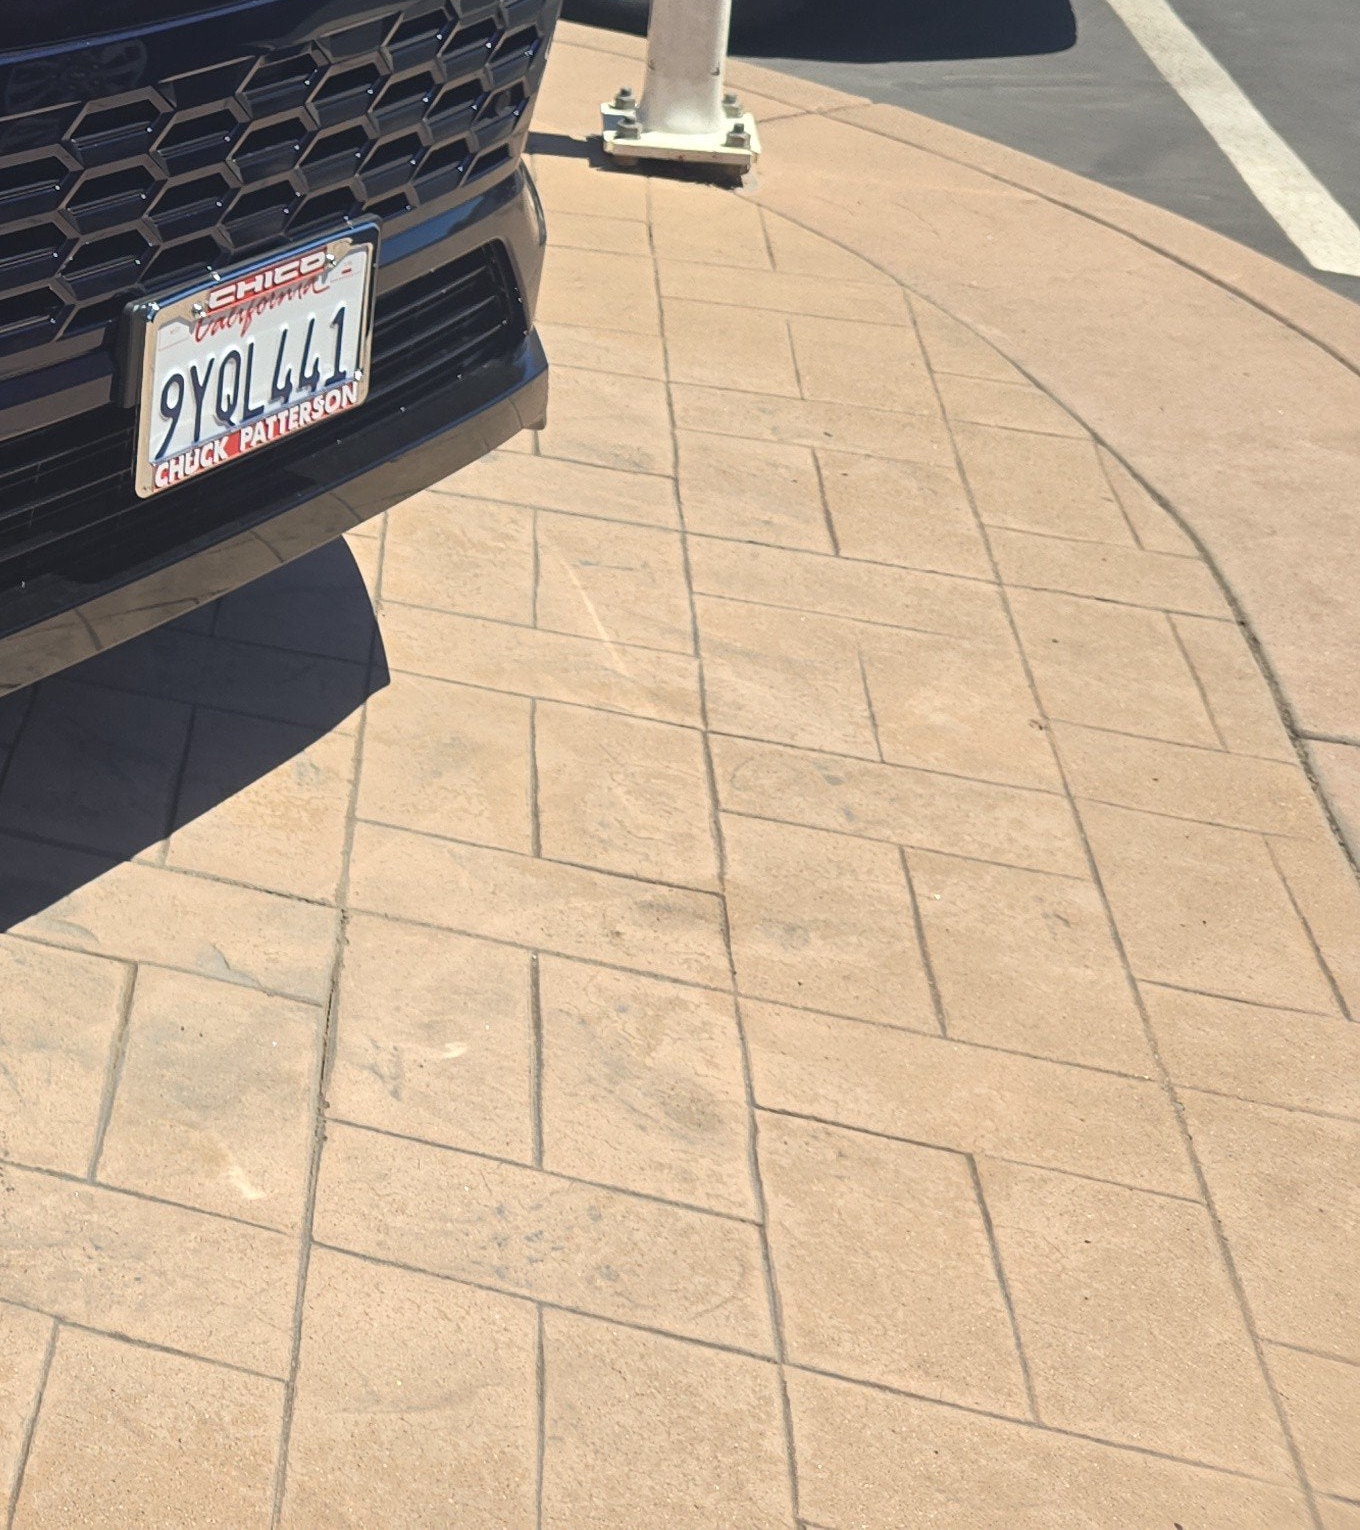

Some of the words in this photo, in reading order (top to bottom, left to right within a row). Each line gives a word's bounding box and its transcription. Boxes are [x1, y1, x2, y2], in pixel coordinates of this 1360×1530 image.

[194, 278, 330, 343] California
[208, 250, 328, 311] CHICO
[154, 306, 347, 459] 9YQL441
[154, 437, 230, 489] CHUCK
[239, 382, 358, 452] PATTERSON
